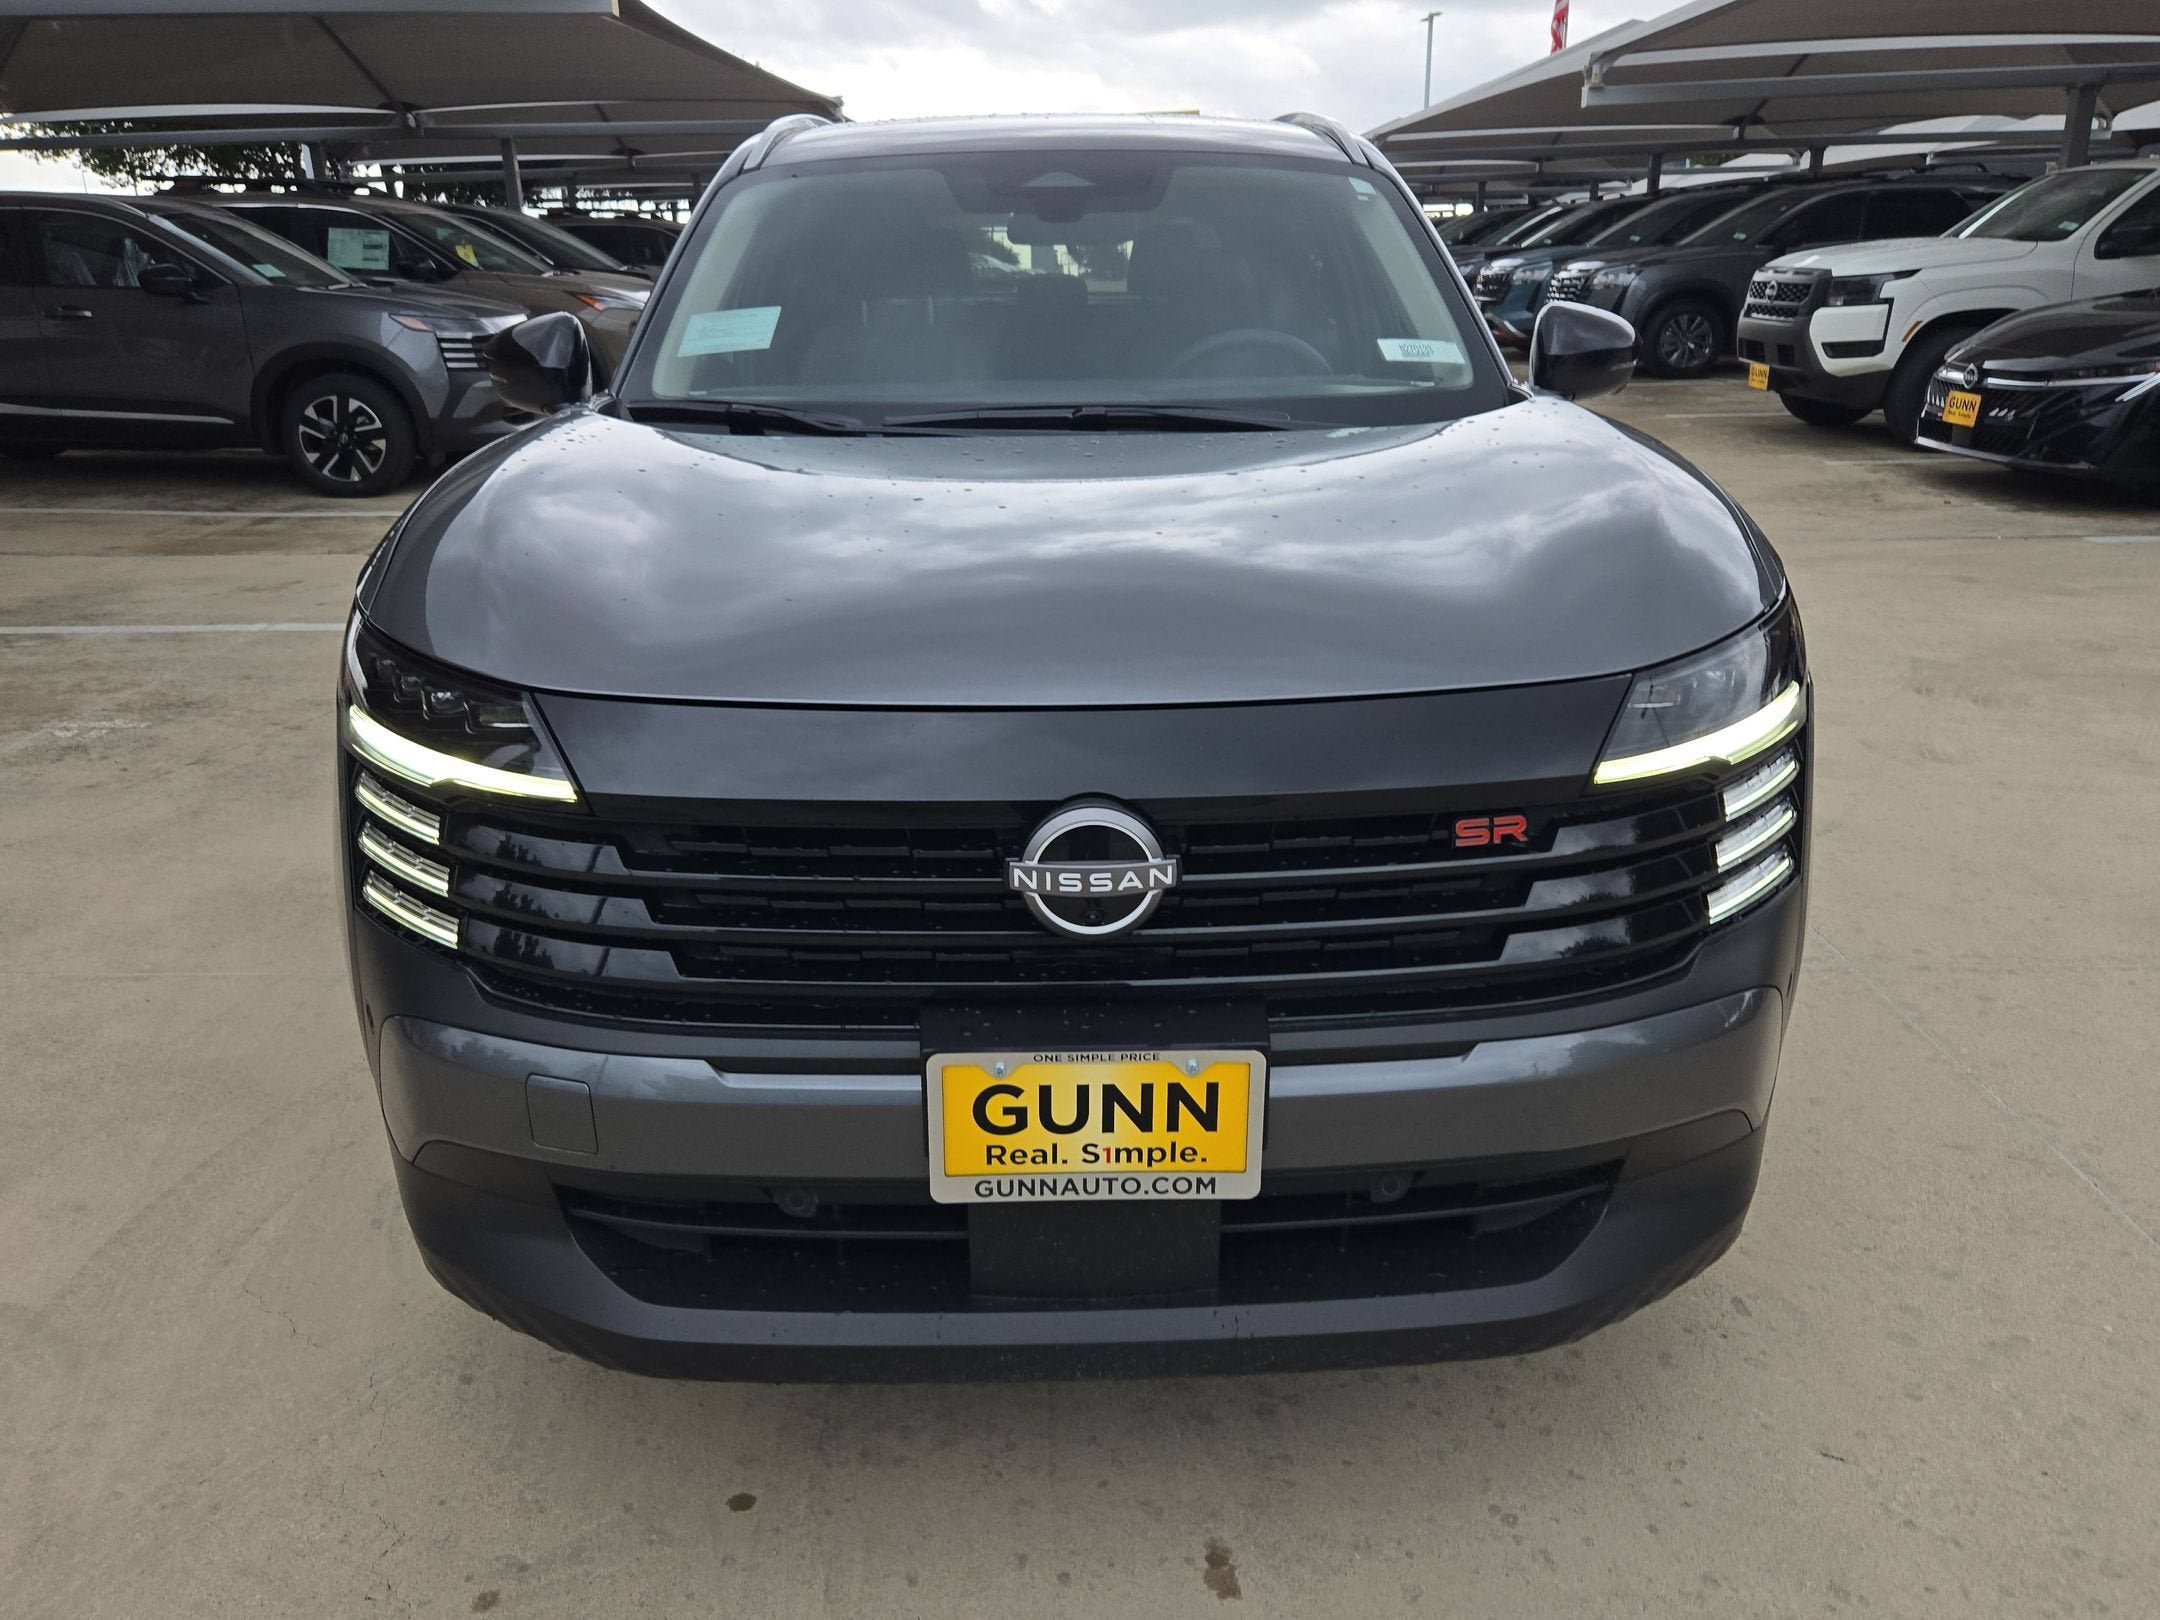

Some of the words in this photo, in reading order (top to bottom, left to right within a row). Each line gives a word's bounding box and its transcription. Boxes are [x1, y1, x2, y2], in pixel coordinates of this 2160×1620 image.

[1949, 396, 1977, 412] GUNN
[1455, 814, 1529, 848] SR
[1013, 864, 1173, 893] NISSAN
[1033, 1053, 1062, 1063] ONE
[1067, 1053, 1116, 1063] SIMPLE
[1120, 1052, 1160, 1062] PRICE
[971, 1082, 1220, 1136] GUNN
[985, 1142, 1068, 1165] Real.
[974, 1176, 1217, 1198] GUNNAUTO.COM
